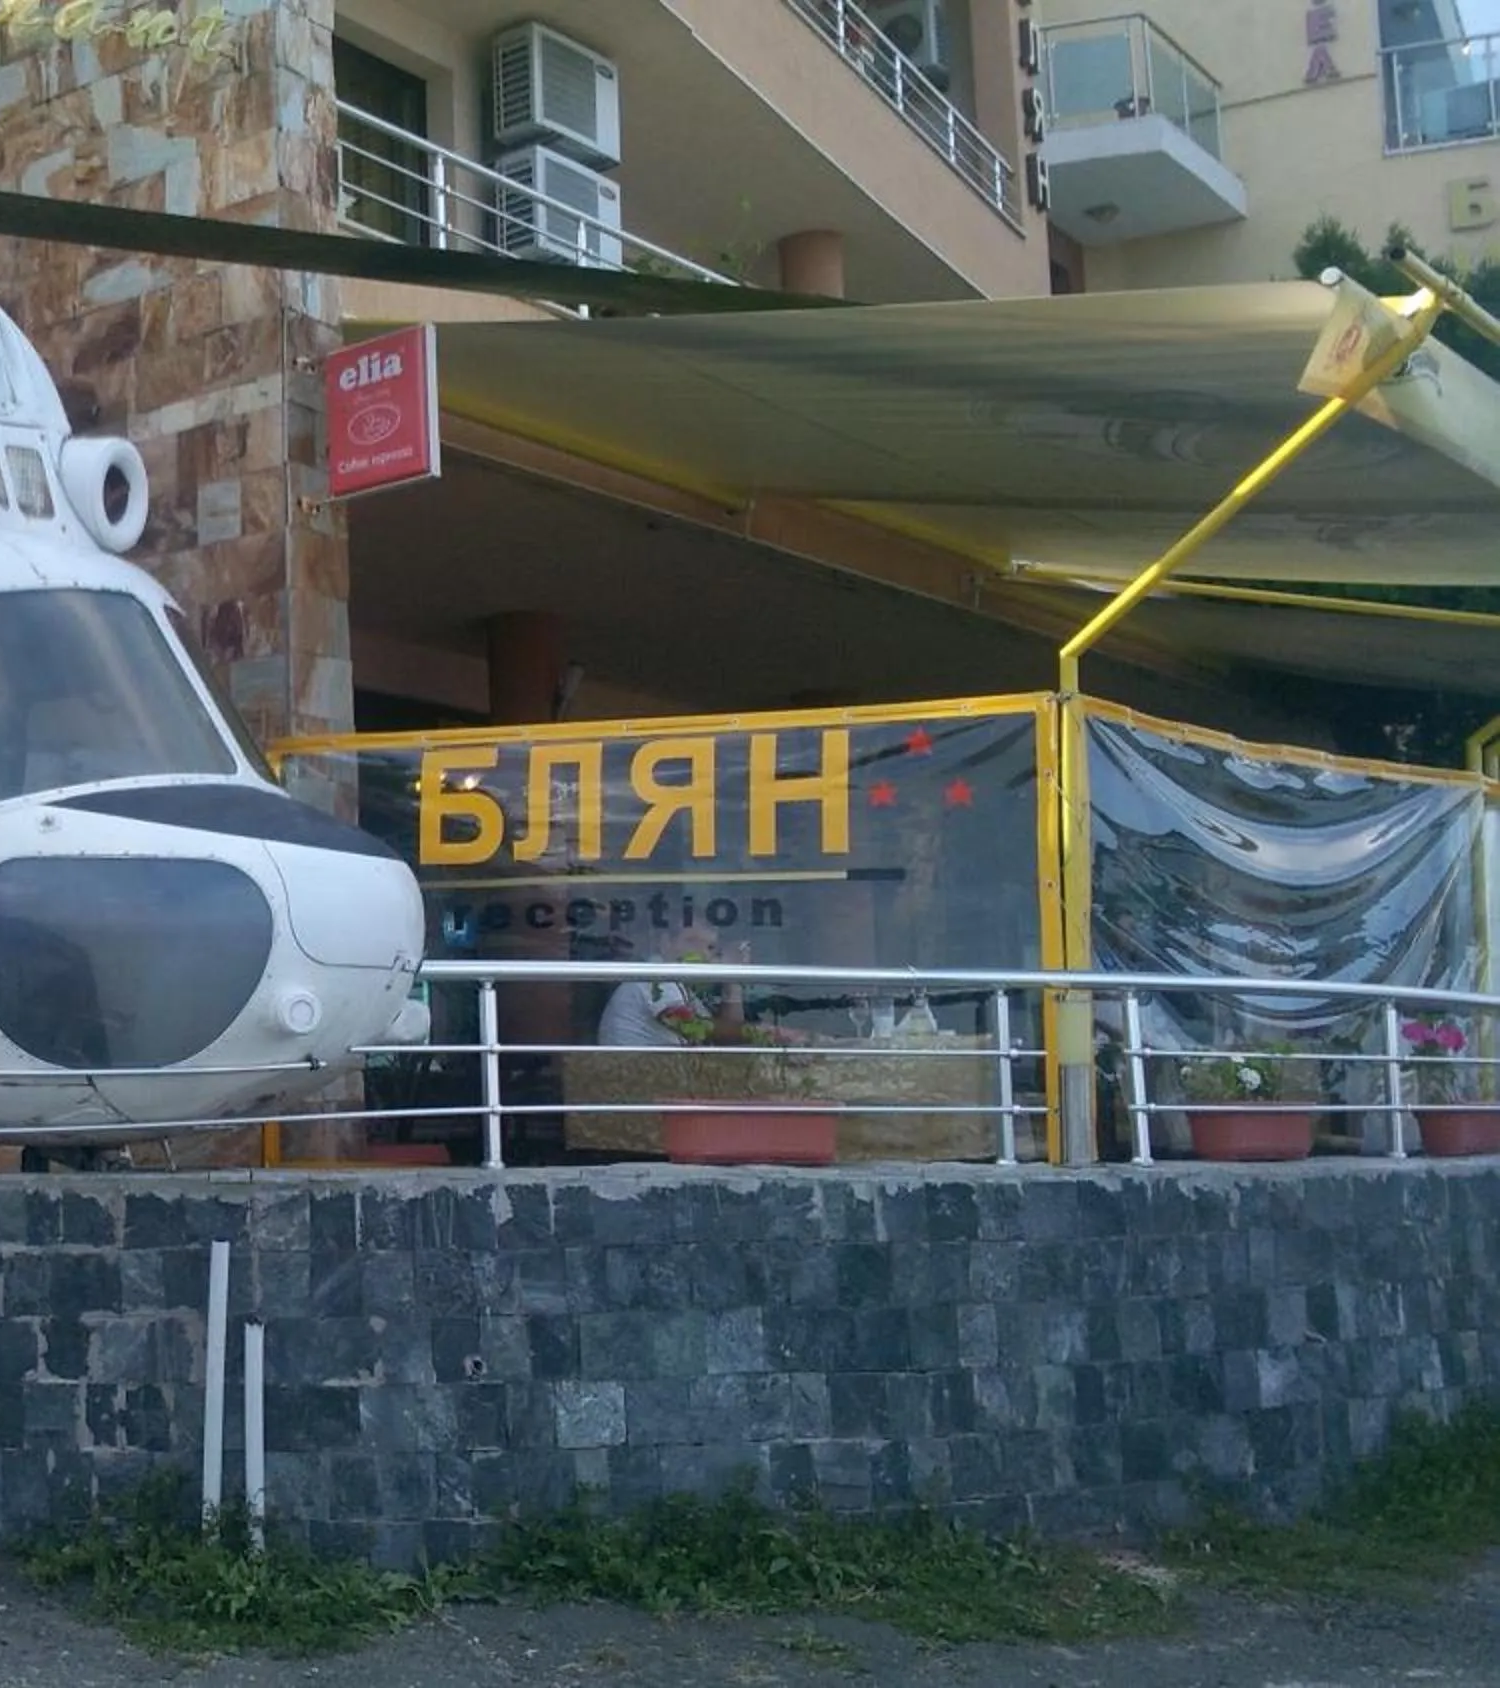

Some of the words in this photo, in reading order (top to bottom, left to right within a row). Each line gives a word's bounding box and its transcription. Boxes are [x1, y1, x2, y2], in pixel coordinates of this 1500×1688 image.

[339, 352, 403, 391] elia
[419, 729, 850, 865] БЛЯН
[443, 893, 784, 931] reception
